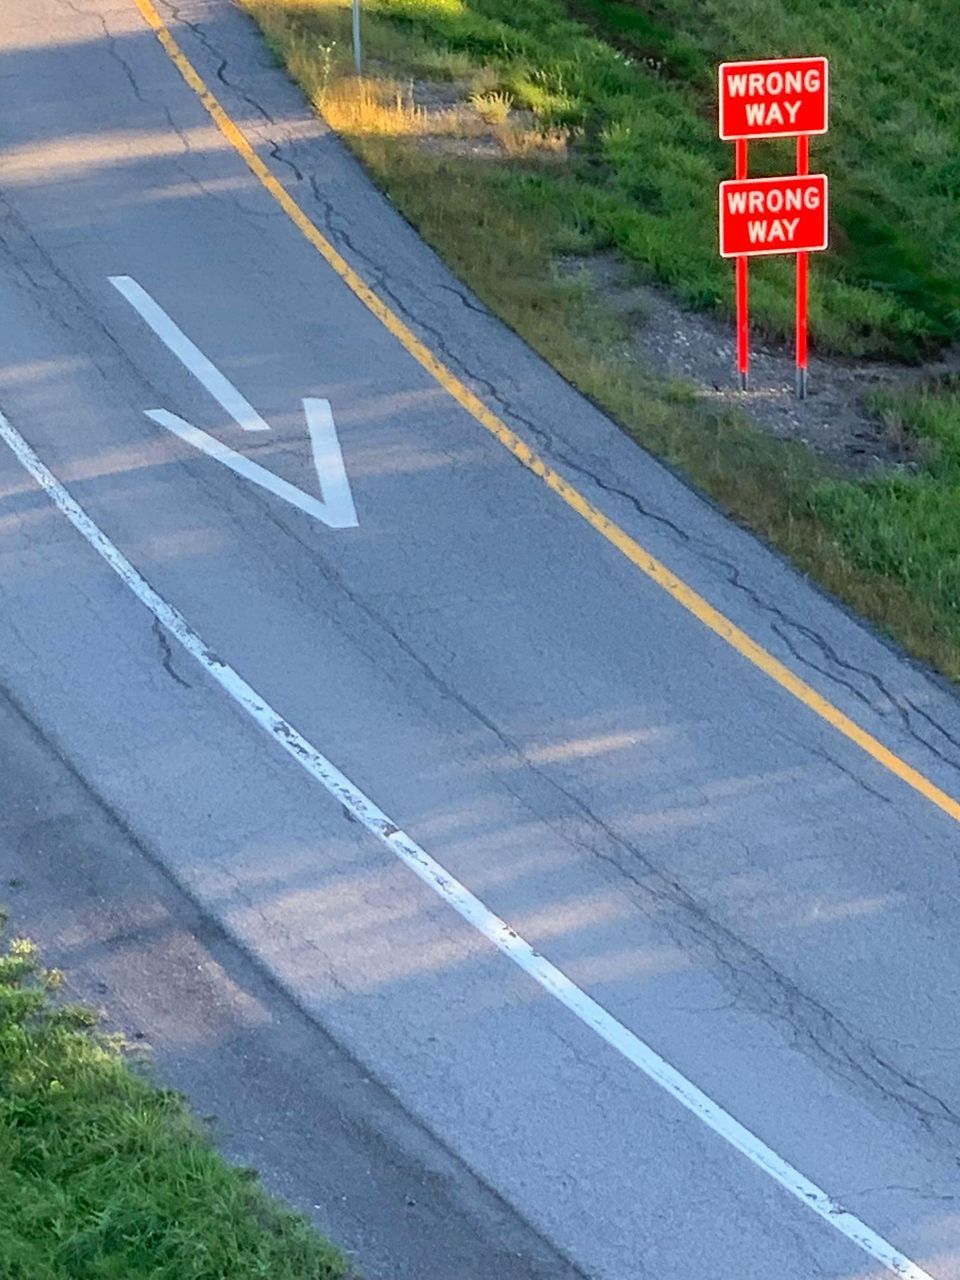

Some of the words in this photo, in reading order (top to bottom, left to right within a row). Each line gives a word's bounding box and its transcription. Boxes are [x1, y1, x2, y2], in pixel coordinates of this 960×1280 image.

[727, 69, 820, 97] WRONG
[745, 100, 801, 126] WAY
[727, 186, 820, 214] WRONG
[748, 218, 799, 243] WAY
